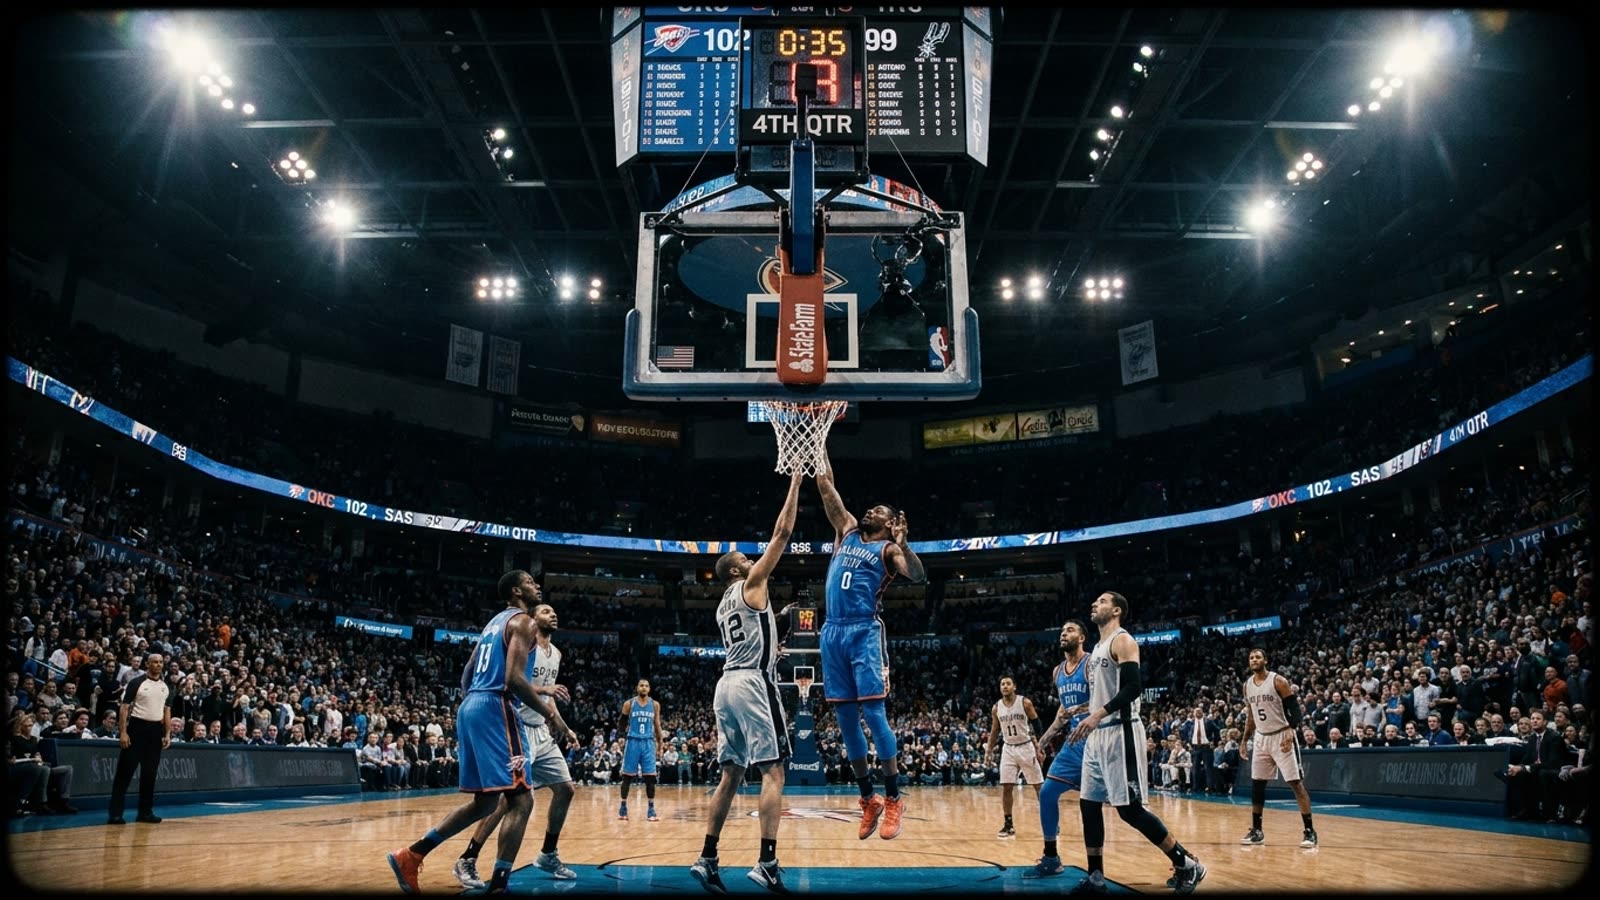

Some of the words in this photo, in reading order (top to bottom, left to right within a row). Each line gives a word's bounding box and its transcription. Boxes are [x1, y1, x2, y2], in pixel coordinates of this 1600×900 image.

[703, 28, 750, 51] 102
[779, 29, 846, 56] 0:35
[866, 28, 898, 51] 99
[752, 114, 798, 134] 4TH
[806, 114, 852, 136] QTR
[1268, 490, 1296, 508] OKC
[1306, 480, 1332, 498] 102
[1350, 466, 1380, 486] SAS
[308, 489, 335, 508] OKC
[346, 499, 368, 516] 102
[384, 508, 414, 524] SAS
[512, 527, 536, 540] QTR
[841, 572, 852, 590] 0
[1258, 709, 1266, 721] 5
